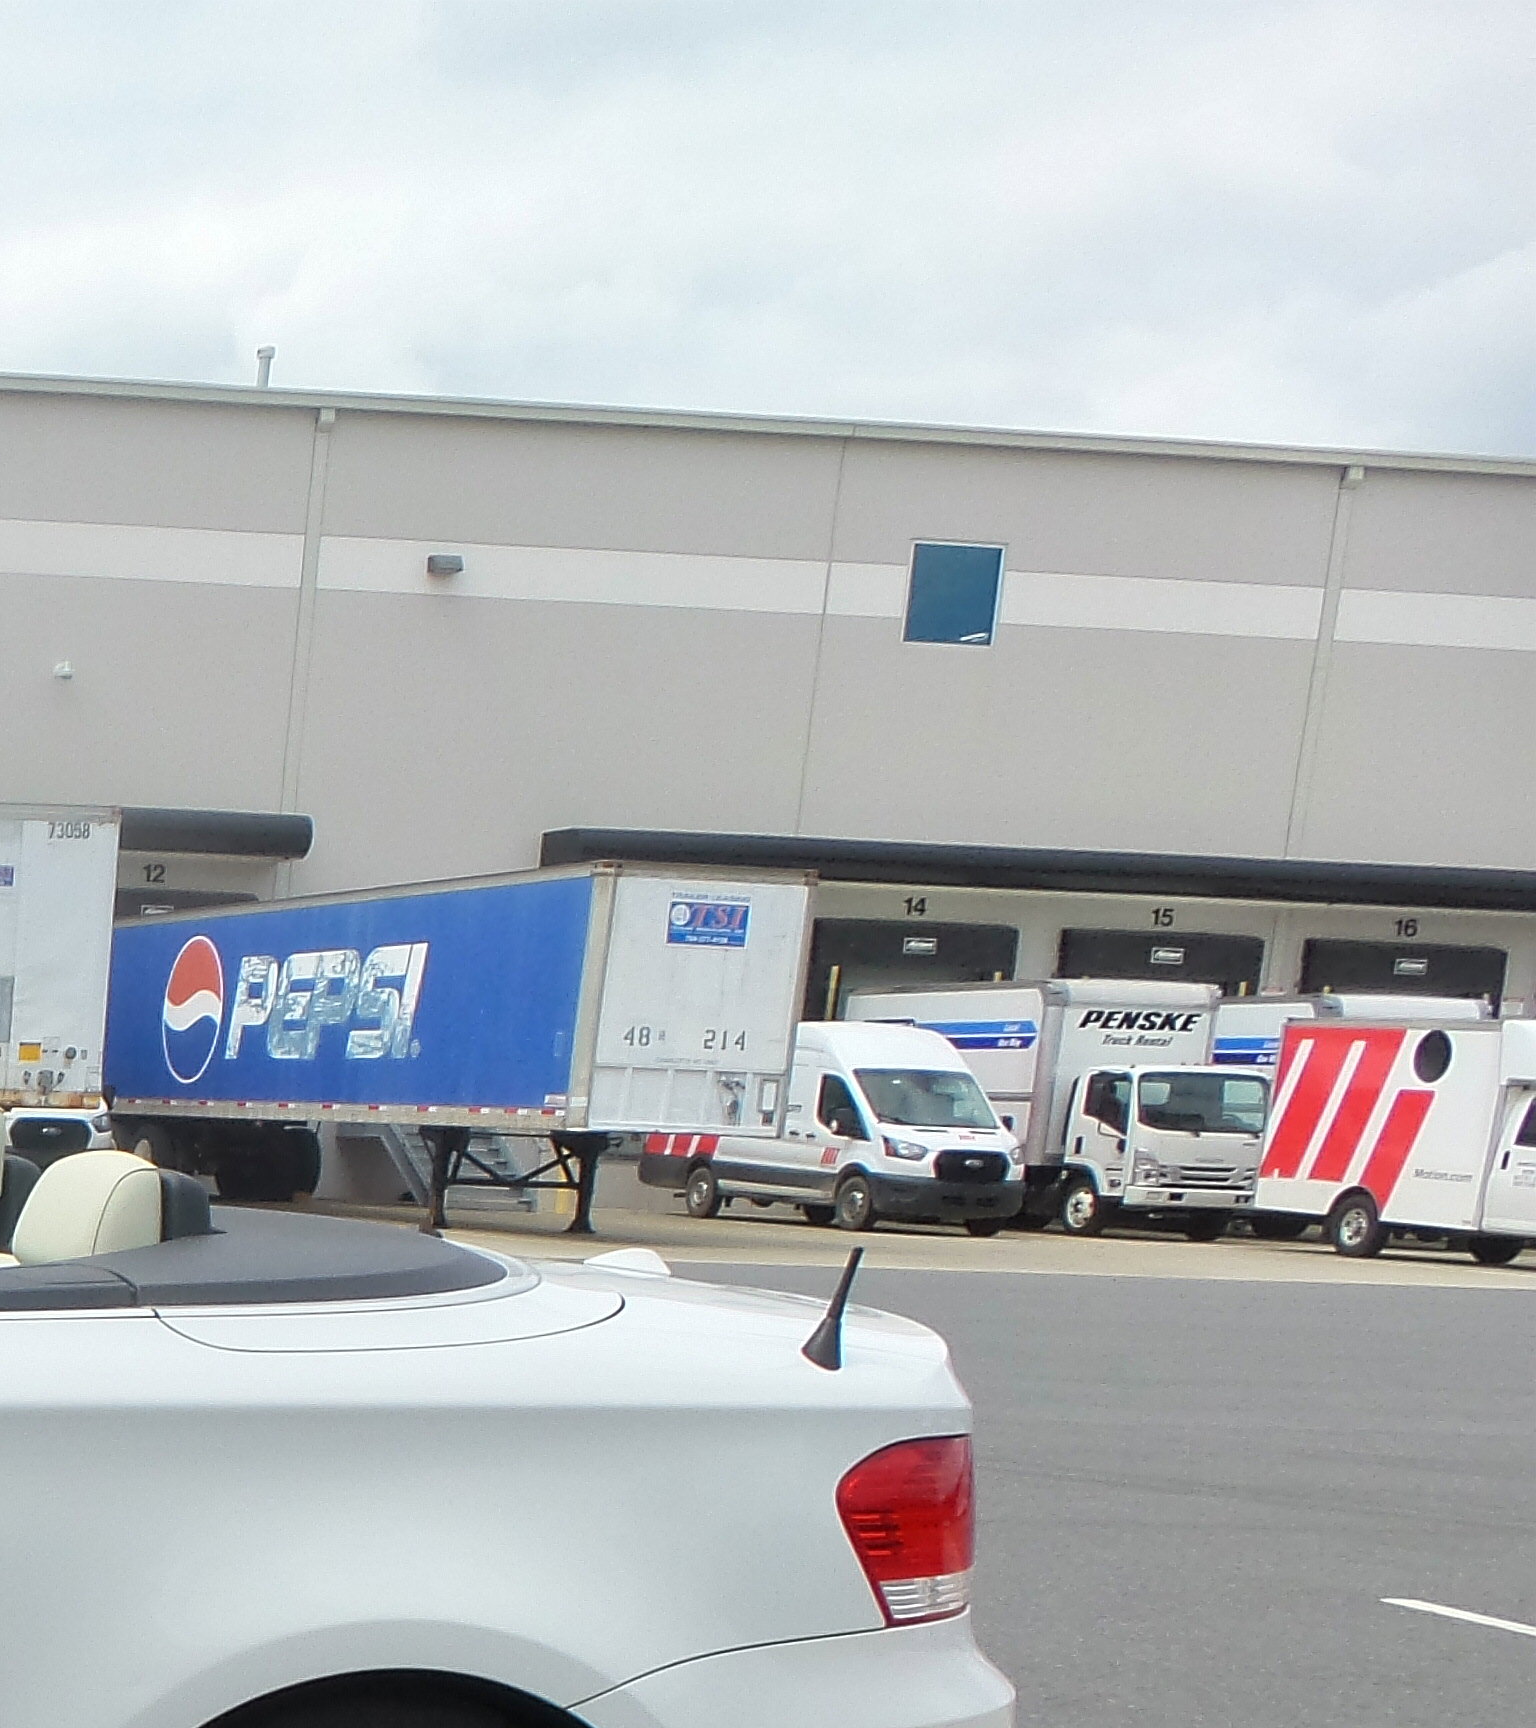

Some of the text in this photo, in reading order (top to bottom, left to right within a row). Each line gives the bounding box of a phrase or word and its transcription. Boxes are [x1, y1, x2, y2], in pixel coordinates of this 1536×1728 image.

[143, 863, 166, 883] 12
[904, 897, 928, 916] 14
[1152, 907, 1175, 927] 15
[1394, 918, 1418, 938] 16
[224, 942, 429, 1060] PEPSI
[1078, 1009, 1203, 1033] PENSKE
[623, 1025, 651, 1047] 48
[703, 1028, 746, 1051] 214
